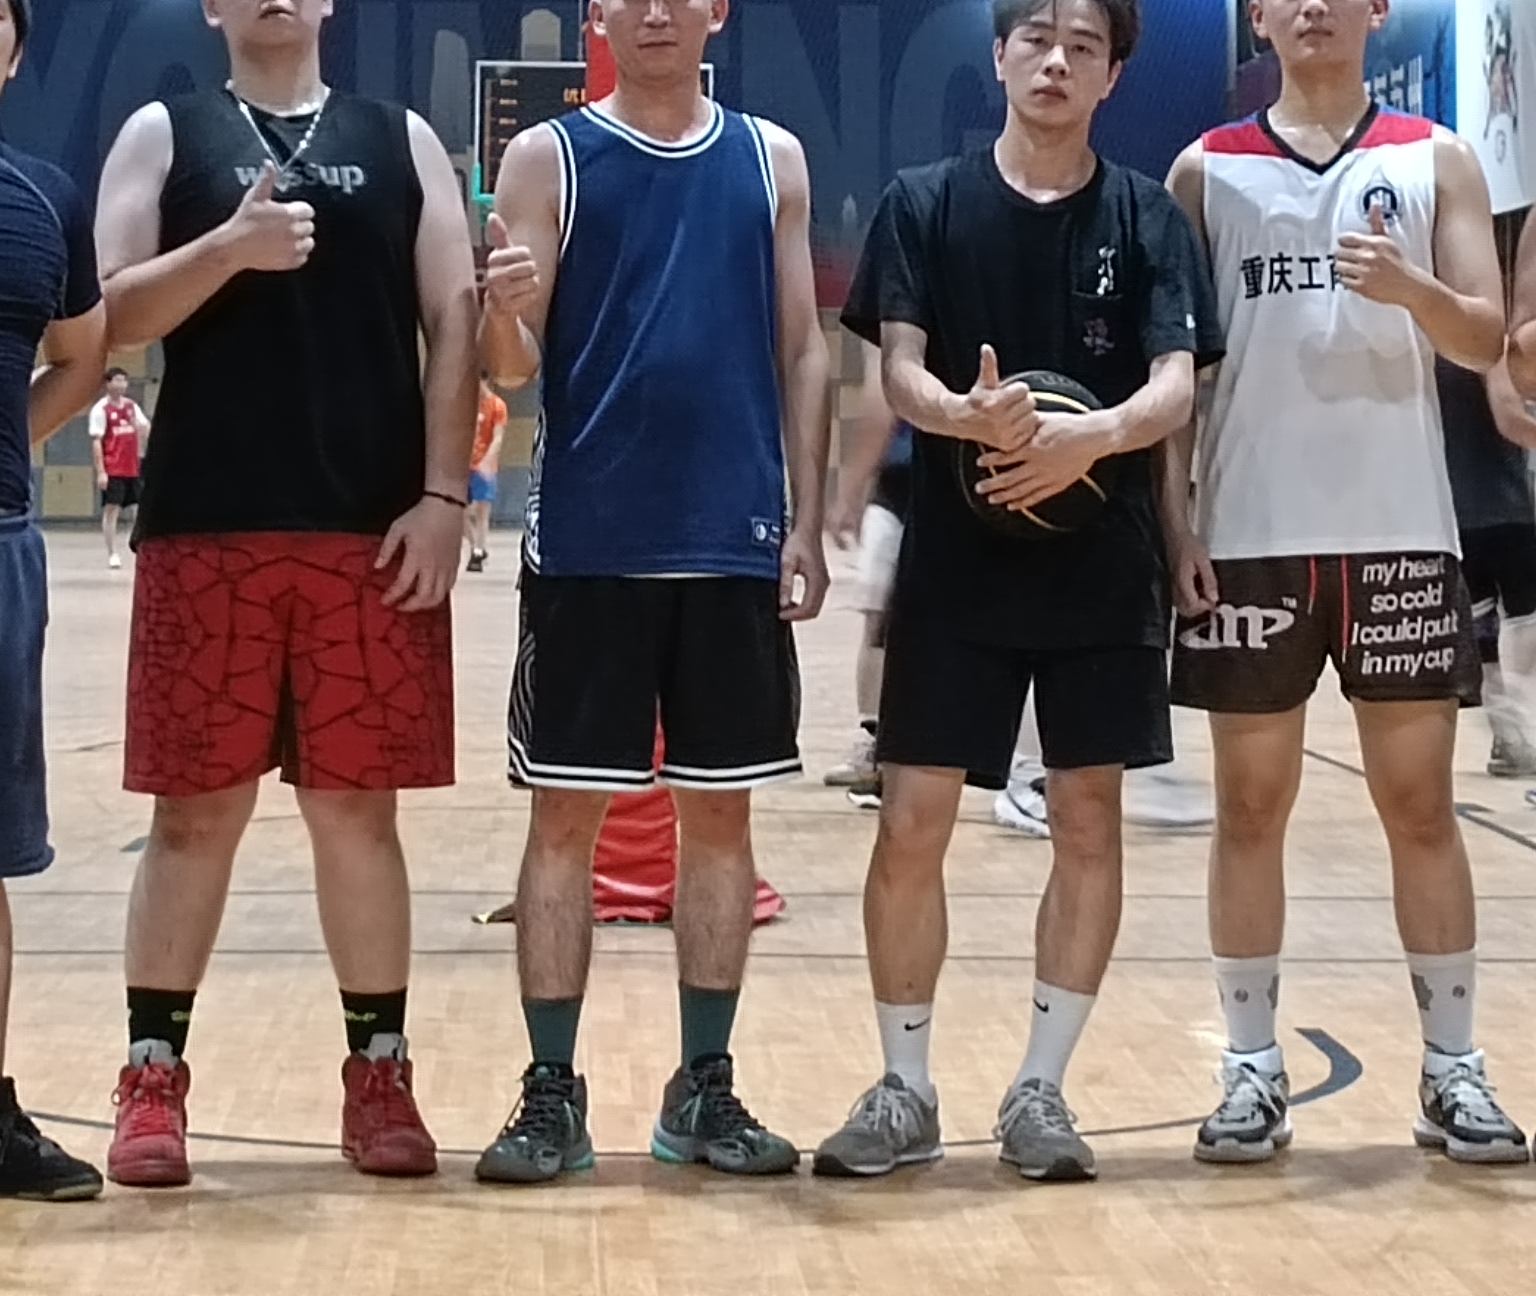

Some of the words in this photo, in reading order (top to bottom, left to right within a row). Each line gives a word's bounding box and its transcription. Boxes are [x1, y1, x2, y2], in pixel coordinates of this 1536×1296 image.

[234, 162, 367, 195] wssup
[1362, 562, 1398, 586] my
[1398, 554, 1445, 581] heart
[1370, 593, 1399, 614] so
[1400, 582, 1443, 611] cold
[1351, 621, 1360, 645] I
[1360, 615, 1423, 645] could
[1423, 612, 1450, 645] put
[1361, 650, 1383, 675] in
[1385, 652, 1424, 678] my
[1424, 647, 1455, 673] cup
